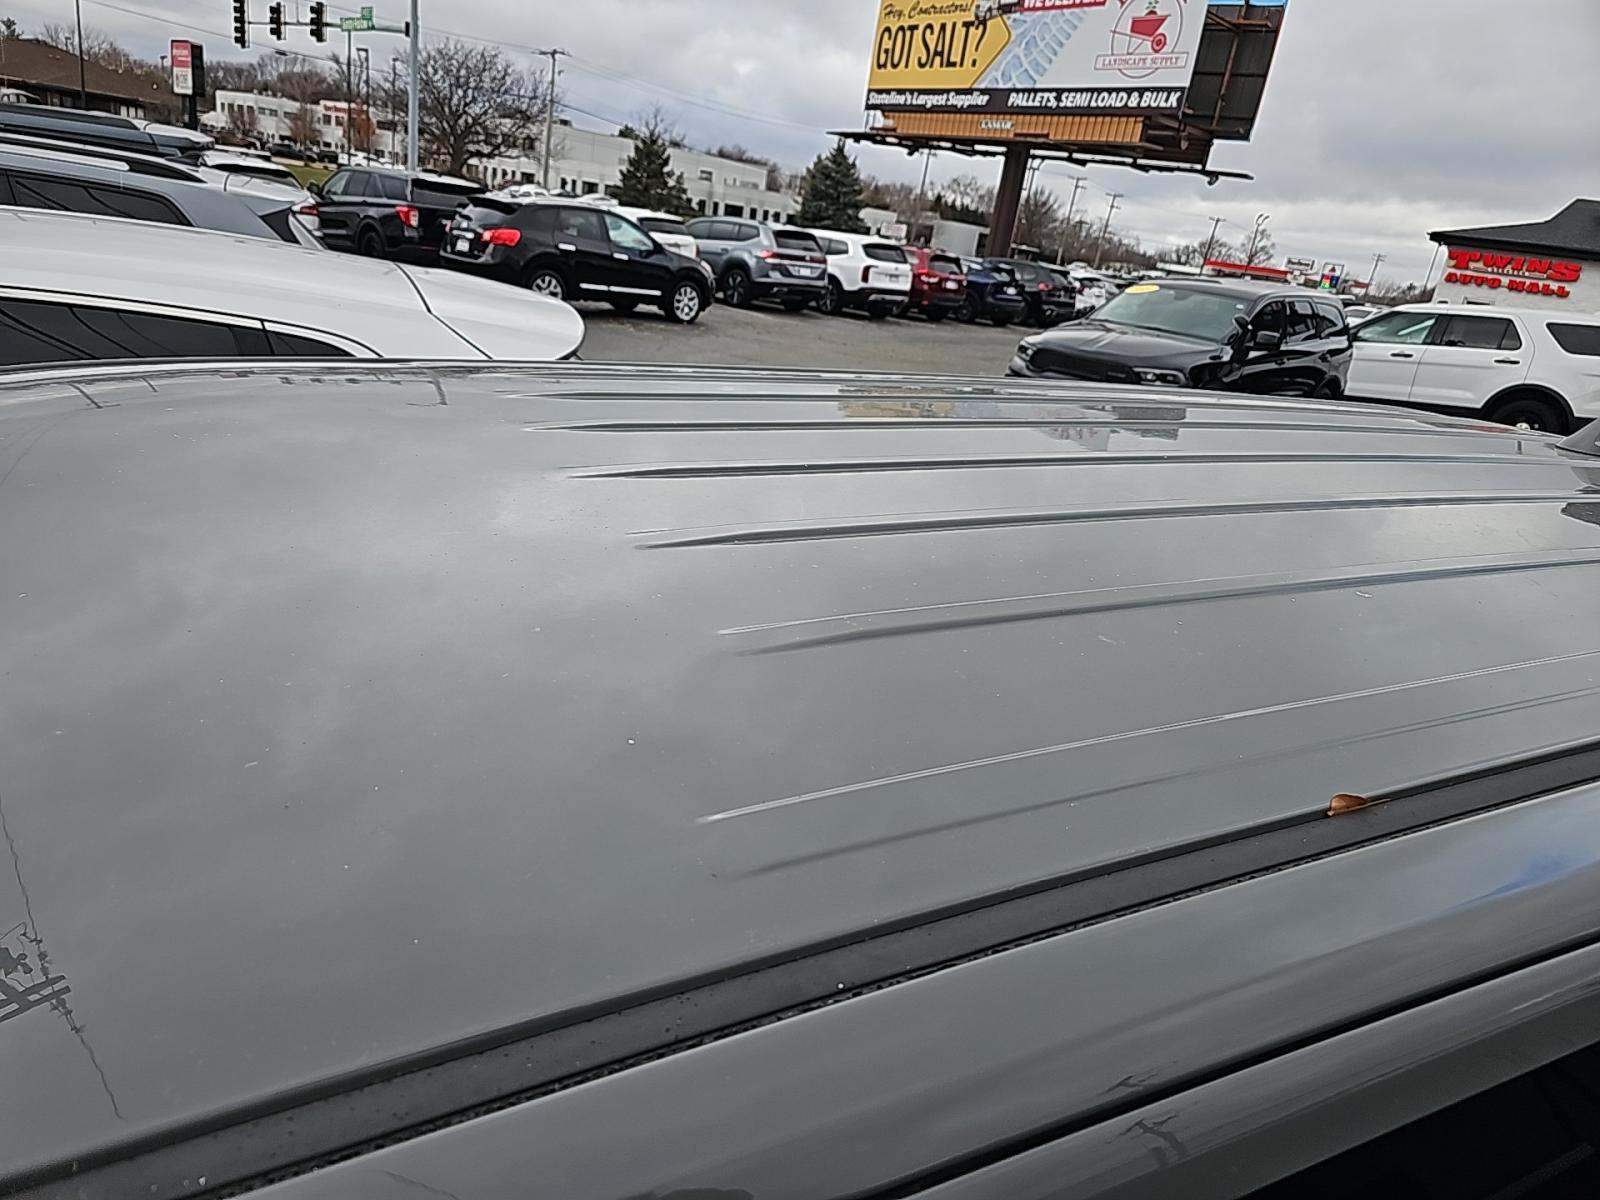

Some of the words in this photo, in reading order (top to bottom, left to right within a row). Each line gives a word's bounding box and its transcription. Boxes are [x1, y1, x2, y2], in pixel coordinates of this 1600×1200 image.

[876, 24, 919, 70] GOT
[917, 19, 988, 69] SALT?
[1102, 57, 1147, 67] LANDSCAPE
[1151, 56, 1180, 66] SUPPLY
[912, 91, 947, 108] Largest
[947, 92, 990, 108] Supplier
[1007, 92, 1058, 109] PALLETS,
[1058, 92, 1091, 107] SEMI
[1090, 92, 1128, 107] LOAD
[1127, 92, 1140, 107] &
[1139, 91, 1181, 108] BULK
[1447, 248, 1582, 283] TWINS
[1444, 271, 1502, 289] AUTO
[1507, 279, 1570, 298] MALL
